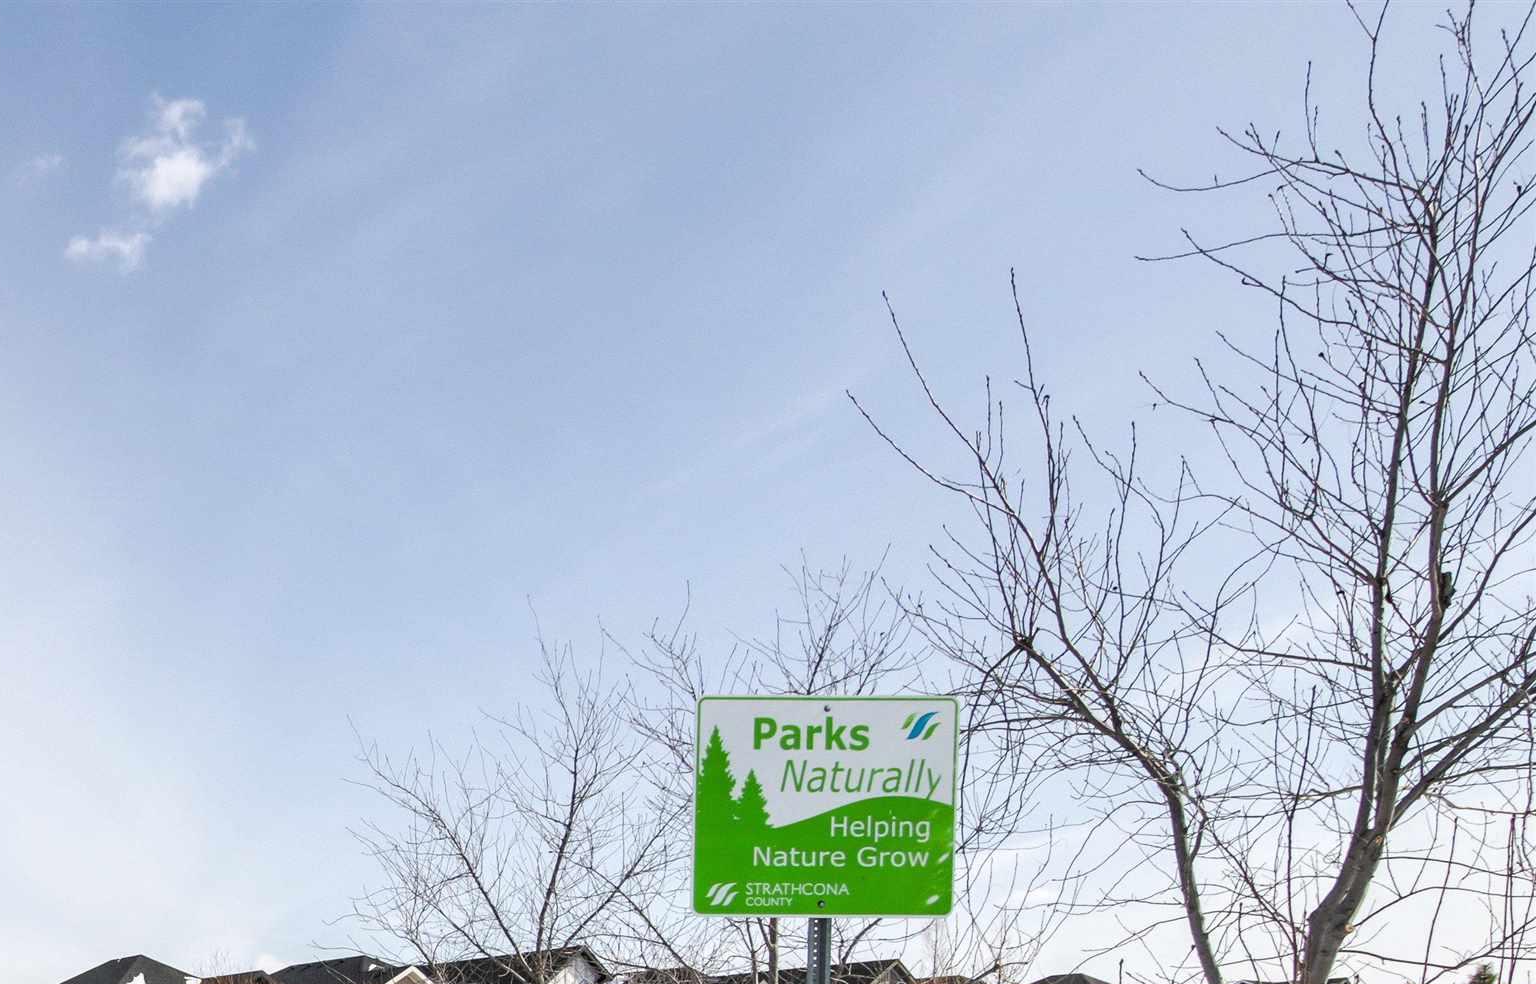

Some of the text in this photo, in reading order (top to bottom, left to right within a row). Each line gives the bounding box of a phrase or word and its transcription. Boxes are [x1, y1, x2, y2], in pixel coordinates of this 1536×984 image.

[753, 716, 871, 752] Parks
[780, 759, 942, 800] Naturally
[830, 816, 931, 843] Helping
[753, 847, 929, 867] Nature Grow
[745, 882, 850, 896] STRATHCONA
[745, 896, 793, 907] COUNTY
